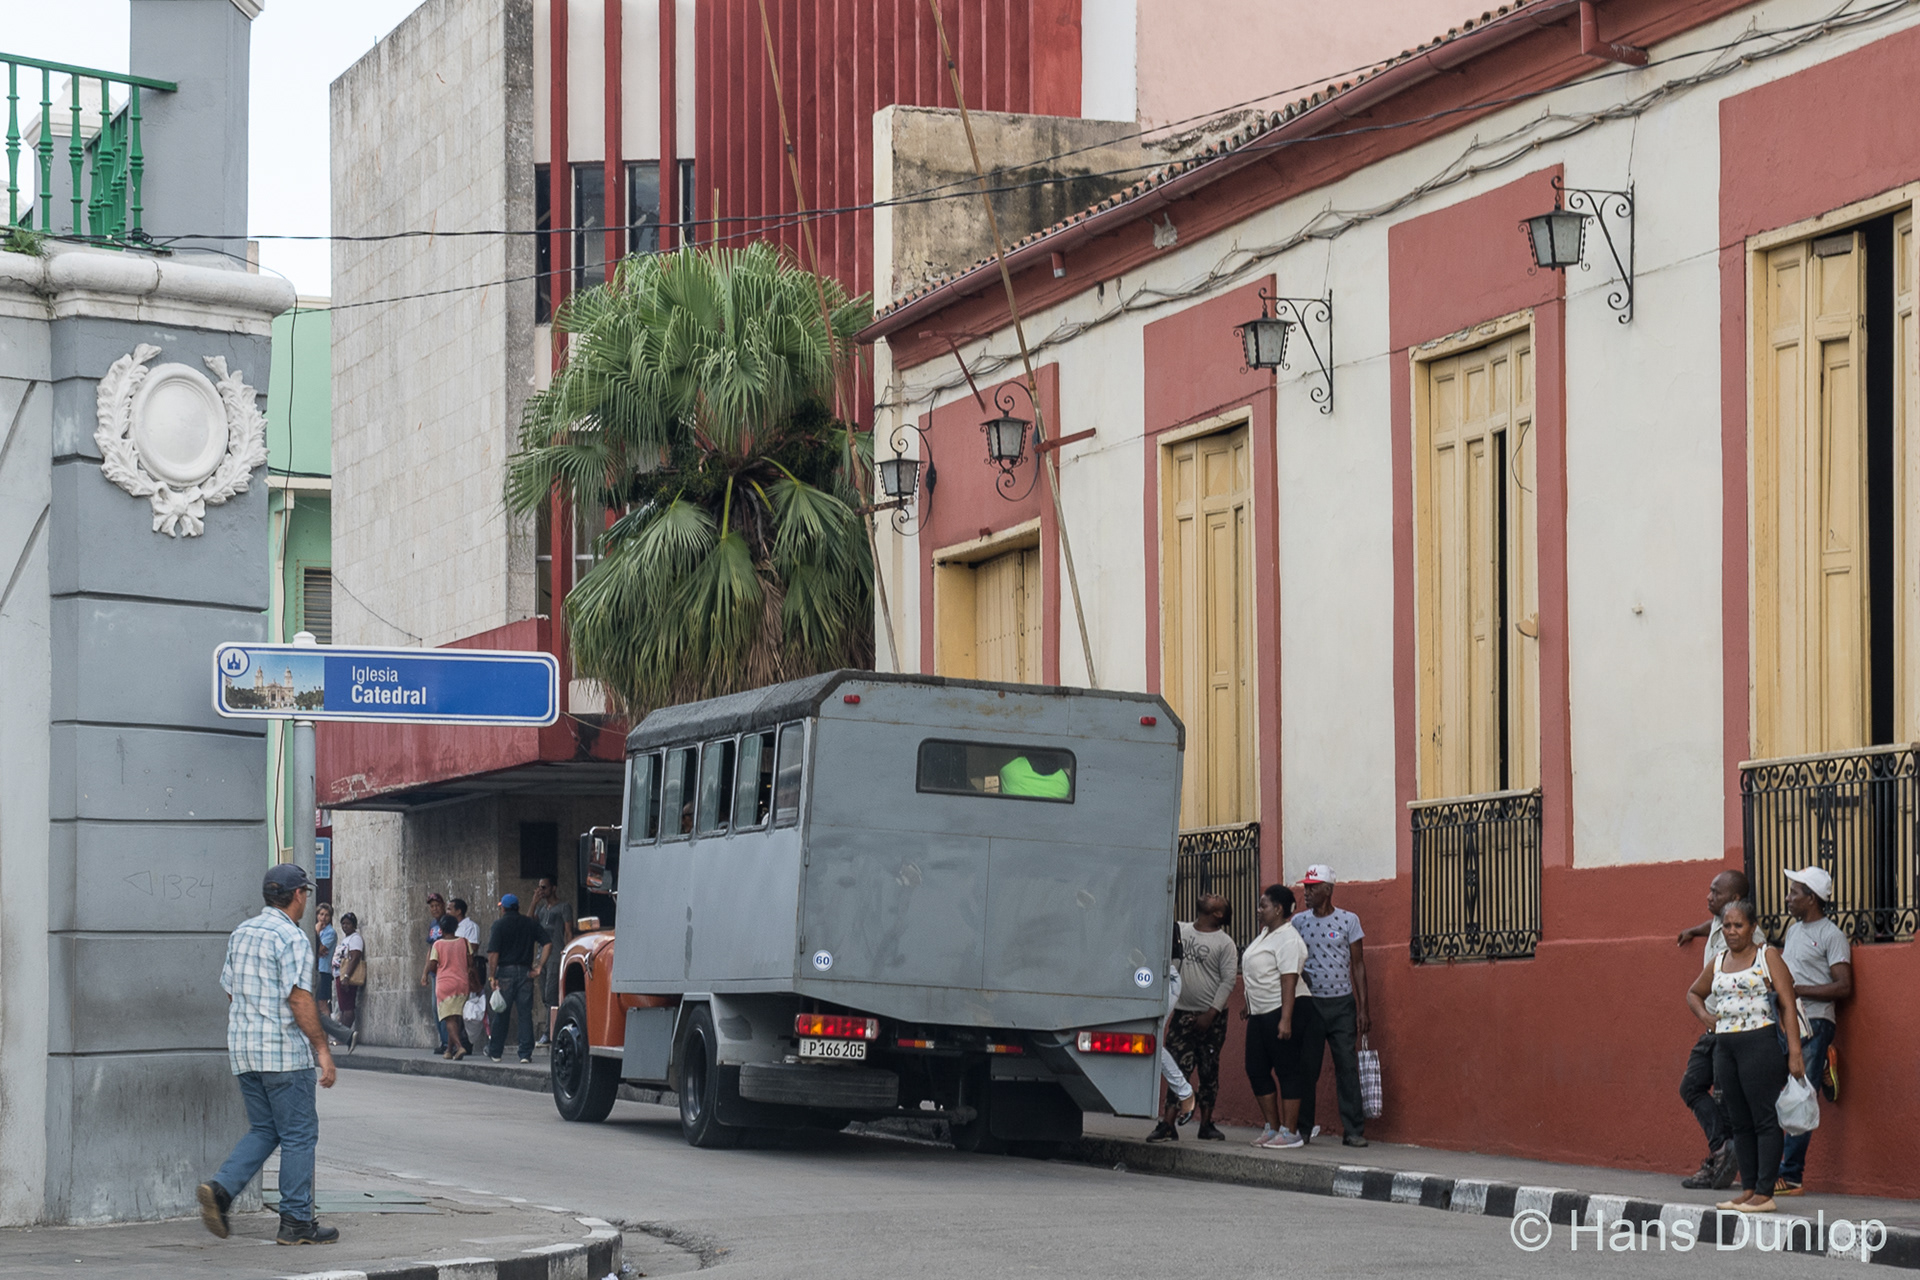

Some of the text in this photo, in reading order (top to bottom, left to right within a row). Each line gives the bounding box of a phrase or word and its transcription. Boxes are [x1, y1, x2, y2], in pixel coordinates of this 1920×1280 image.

[352, 665, 399, 685] Iglesia
[351, 684, 427, 705] Catedral
[816, 955, 830, 965] 60
[1137, 972, 1151, 983] 60
